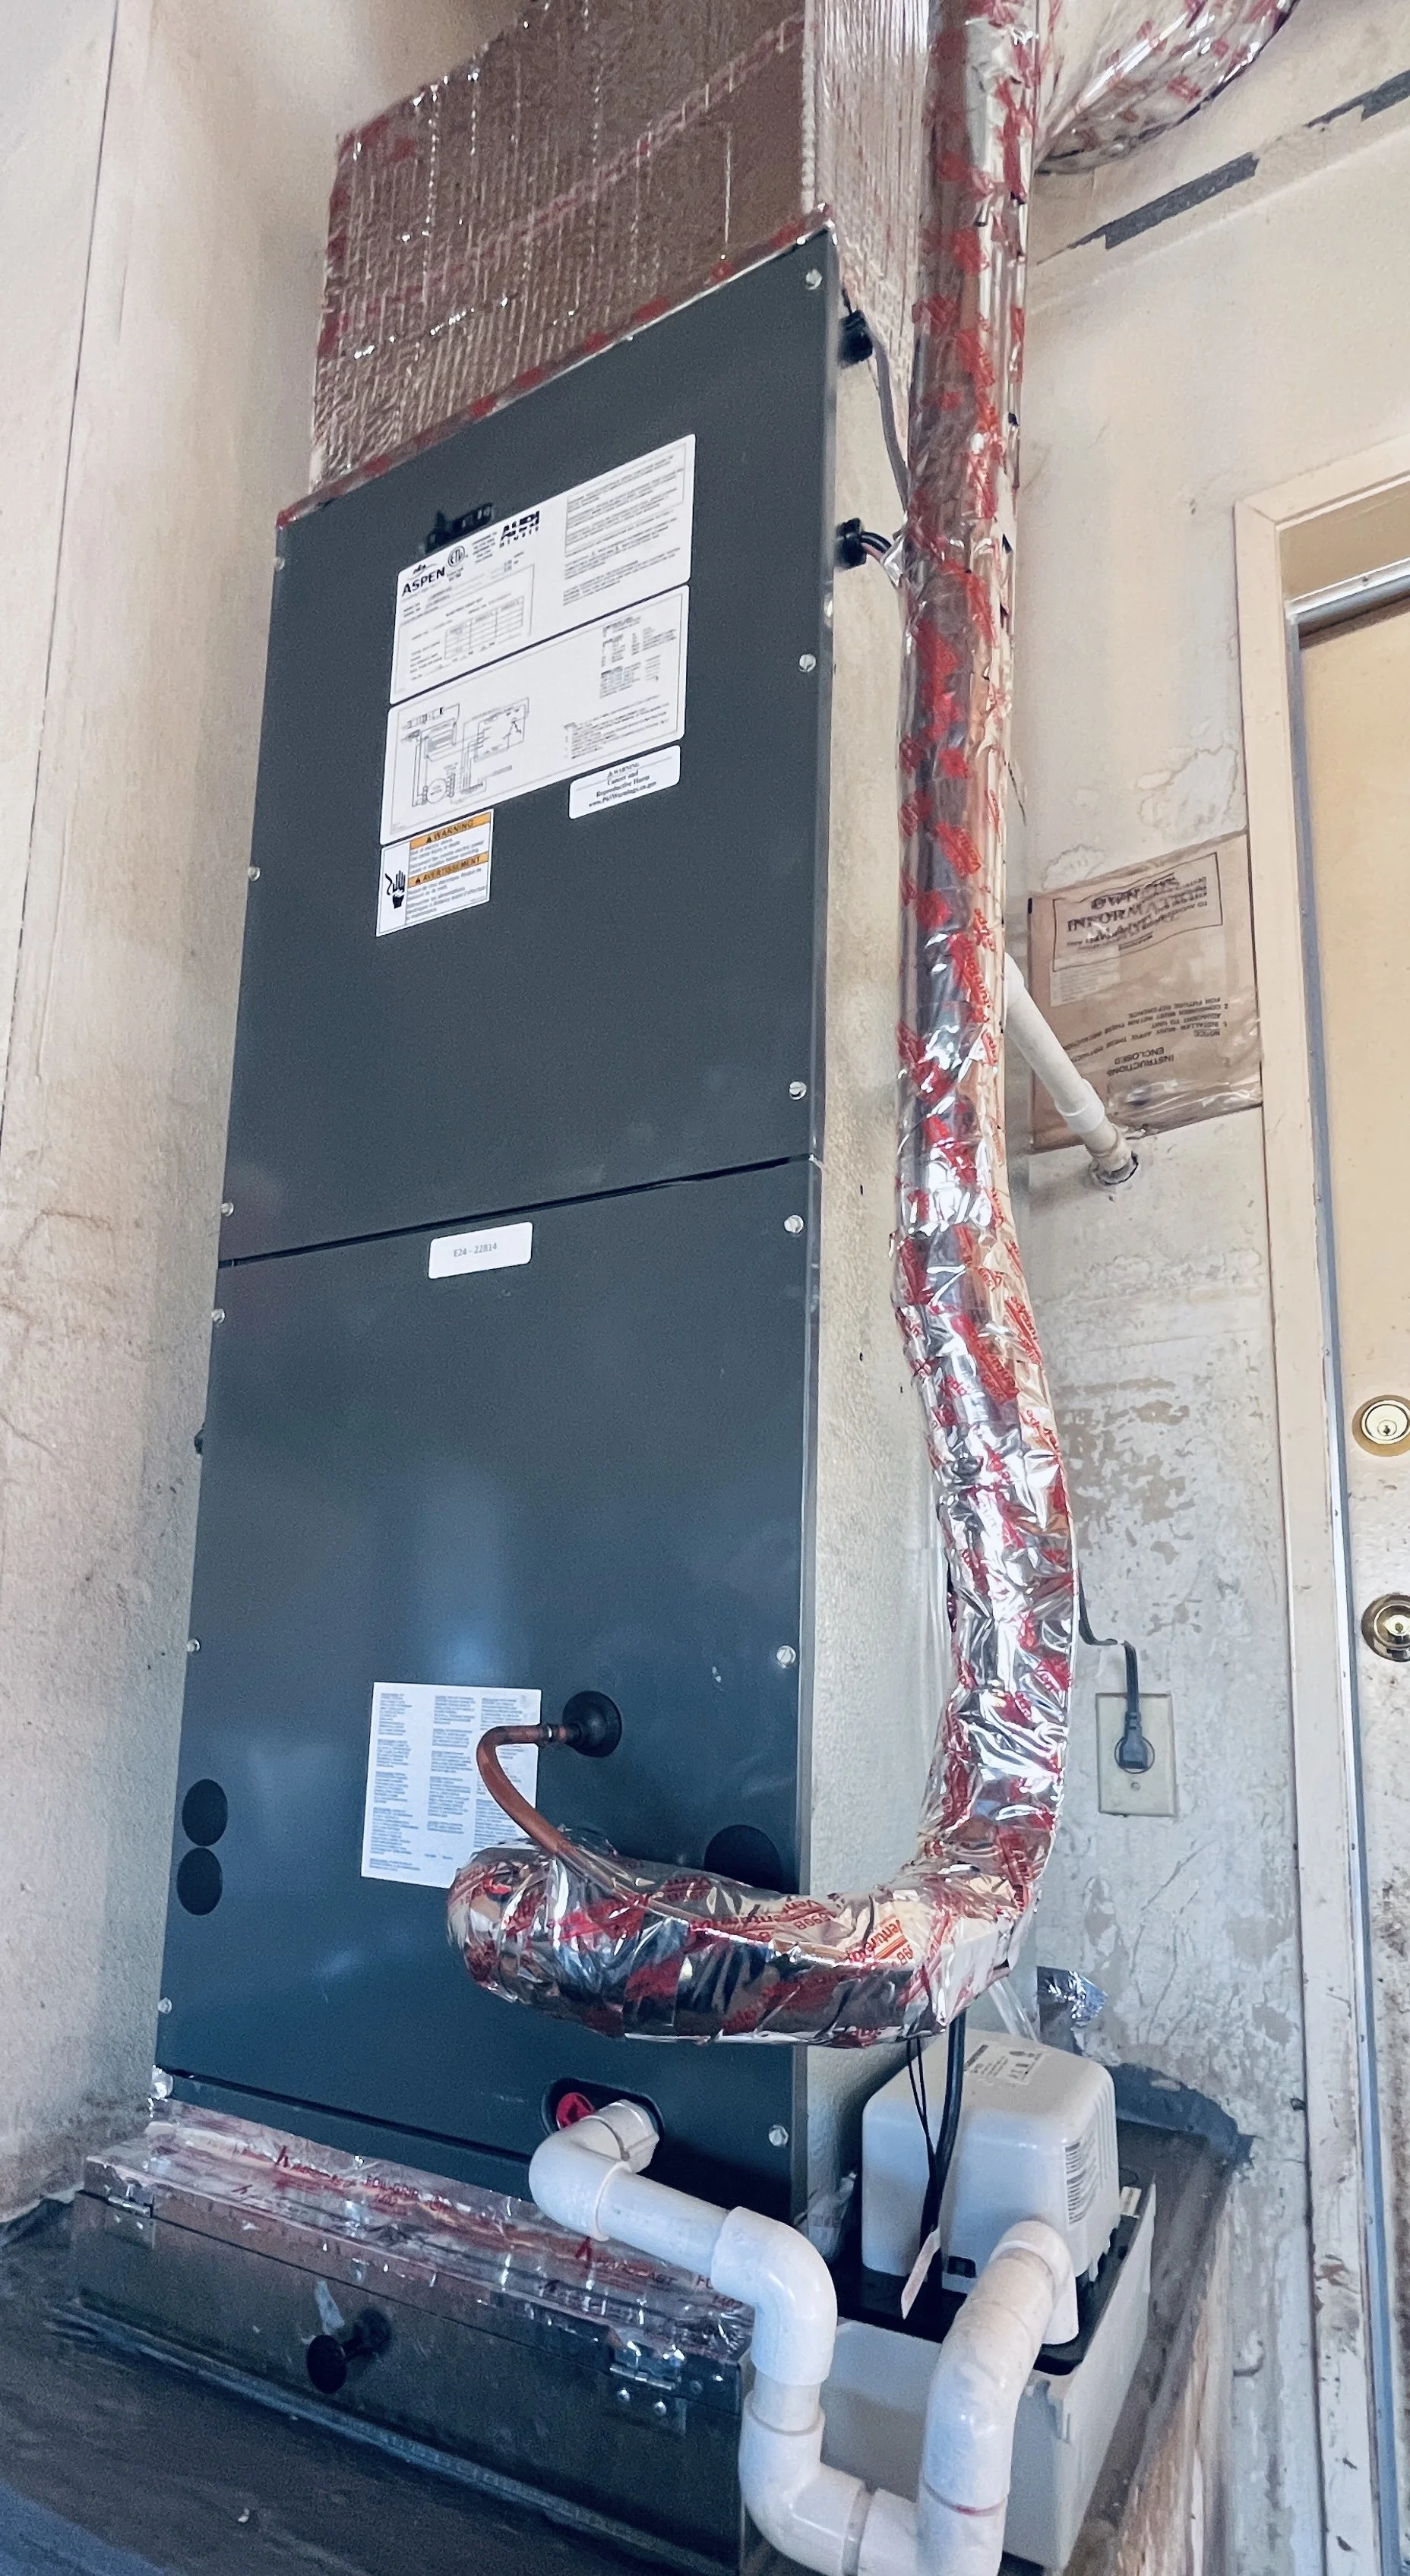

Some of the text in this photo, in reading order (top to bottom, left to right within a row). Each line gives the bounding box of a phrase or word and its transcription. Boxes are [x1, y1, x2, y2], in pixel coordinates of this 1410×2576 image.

[402, 567, 445, 597] ASPEN
[628, 770, 638, 778] and
[433, 819, 474, 840] WARNING
[423, 856, 480, 880] AVERTISSEMENT
[1106, 1054, 1174, 1077] INSTRUCTIONS
[1114, 1047, 1164, 1065] ENCLOSED
